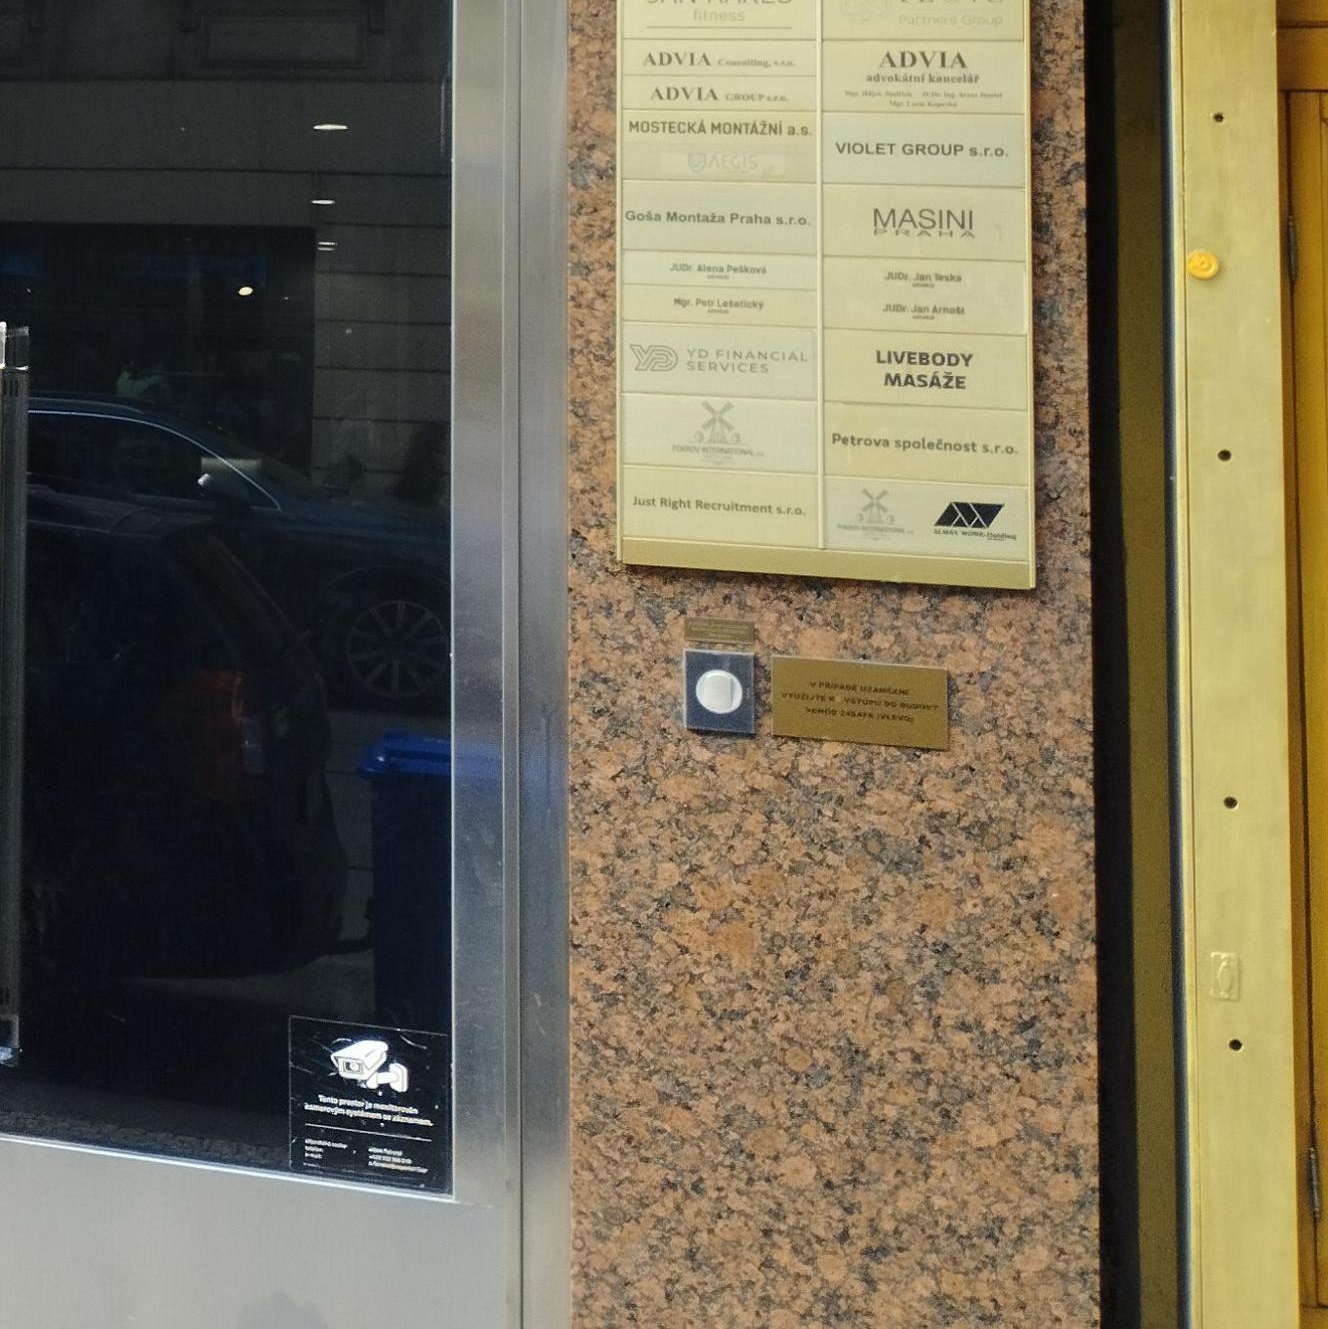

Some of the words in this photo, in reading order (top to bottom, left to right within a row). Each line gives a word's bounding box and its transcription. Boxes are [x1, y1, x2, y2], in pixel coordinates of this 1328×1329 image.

[643, 51, 711, 66] ADVIA
[880, 50, 968, 69] ADVIA
[866, 73, 925, 84] advokátní
[928, 73, 980, 84] kancelář
[650, 86, 719, 101] ADVIA
[628, 119, 707, 135] MOSTECKÁ
[710, 119, 783, 136] MONTÁŽNÍ
[786, 126, 813, 136] a.s.
[835, 142, 896, 156] VIOLET
[901, 143, 964, 157] GROUP
[968, 146, 1009, 158] s.r.o.
[625, 210, 662, 222] Goša
[666, 211, 725, 224] Montaža
[730, 213, 772, 225] Praha
[775, 216, 811, 226] s.r.o.
[873, 207, 974, 231] MASINI
[873, 229, 975, 239] PRAHA
[696, 264, 725, 273] Alena
[913, 272, 932, 281] Jan
[695, 298, 714, 308] Petr
[910, 304, 930, 314] Jan
[686, 349, 710, 359] YD
[715, 349, 809, 363] FINANCIAL
[875, 350, 974, 367] LIVEBODY
[686, 361, 769, 374] SERVICES
[884, 371, 966, 390] MASÁŽE
[831, 432, 890, 448] Petrova
[894, 436, 977, 453] společnost
[982, 443, 1019, 455] s.r.o.
[632, 496, 657, 507] Just
[660, 497, 691, 510] Right
[695, 500, 773, 514] Recruitment
[776, 506, 806, 517] s.r.o.
